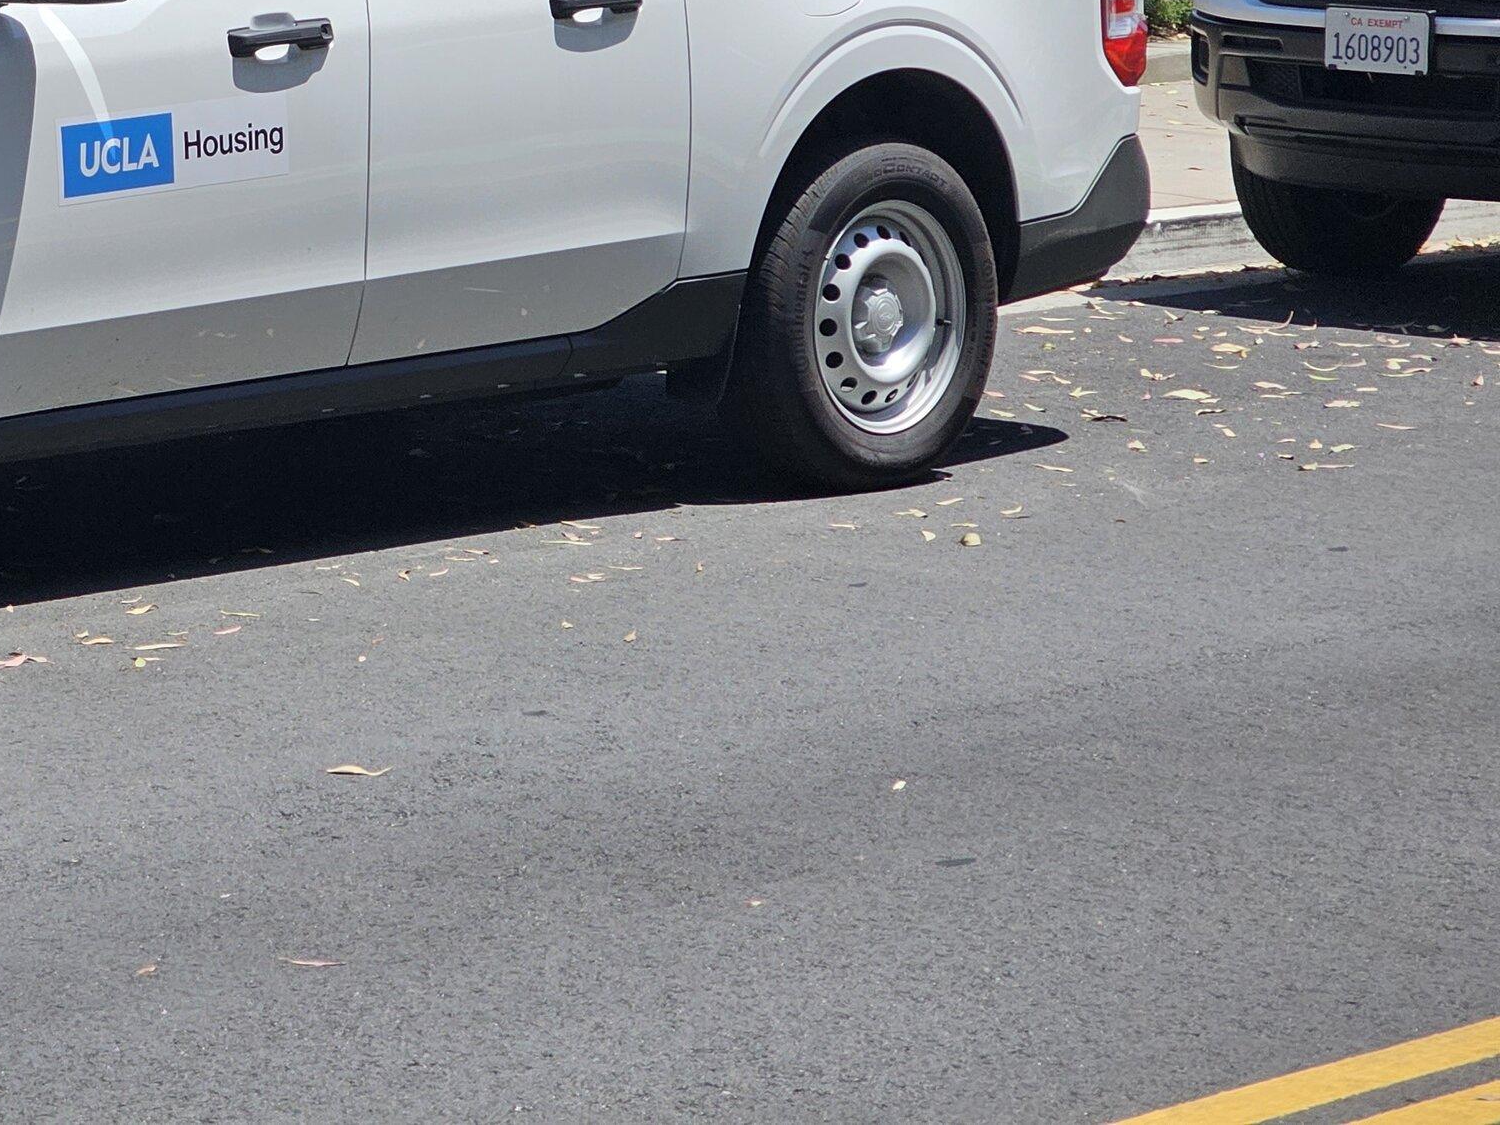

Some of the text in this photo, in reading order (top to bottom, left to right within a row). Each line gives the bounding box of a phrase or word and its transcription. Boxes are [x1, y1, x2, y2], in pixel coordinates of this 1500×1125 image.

[1351, 17, 1403, 29] CA EXEMPT
[1332, 32, 1420, 65] 1608903
[79, 122, 284, 178] UCLA Housing
